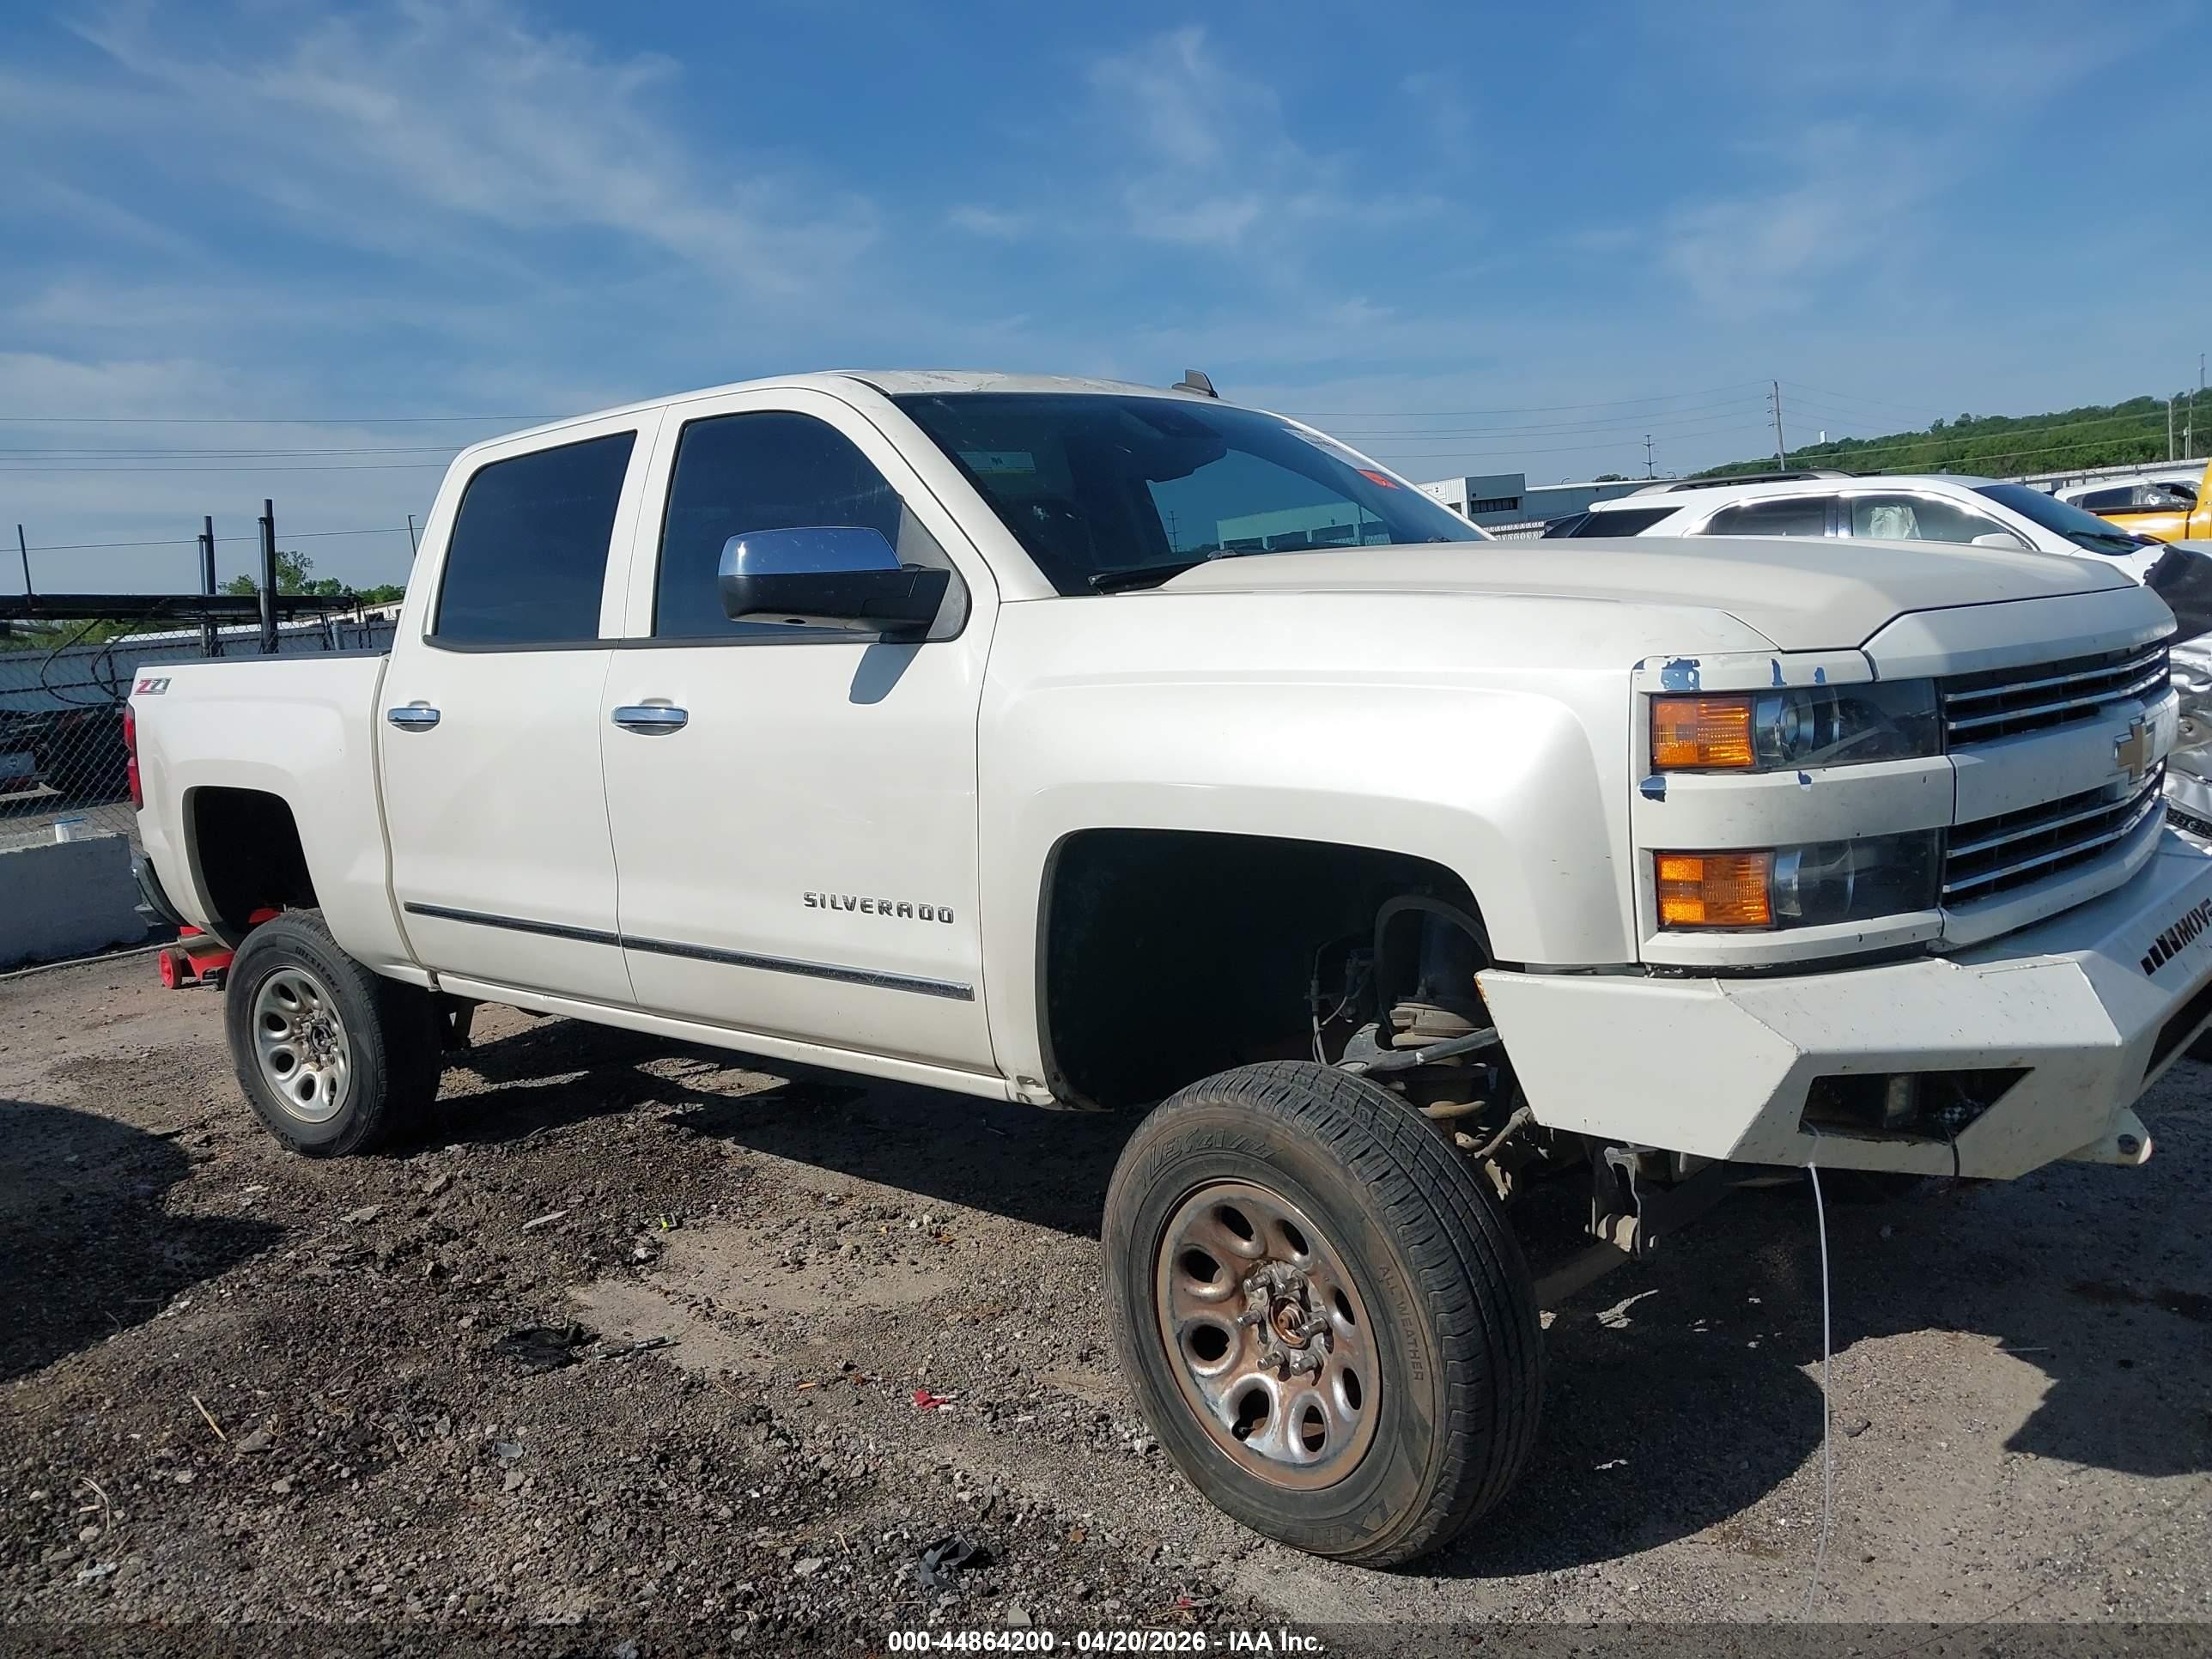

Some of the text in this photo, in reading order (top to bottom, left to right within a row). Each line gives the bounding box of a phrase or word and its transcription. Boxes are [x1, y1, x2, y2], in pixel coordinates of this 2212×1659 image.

[134, 677, 173, 696] Z71
[803, 891, 955, 925] SILVERADO
[1379, 1266, 1425, 1381] ALL WEATHER
